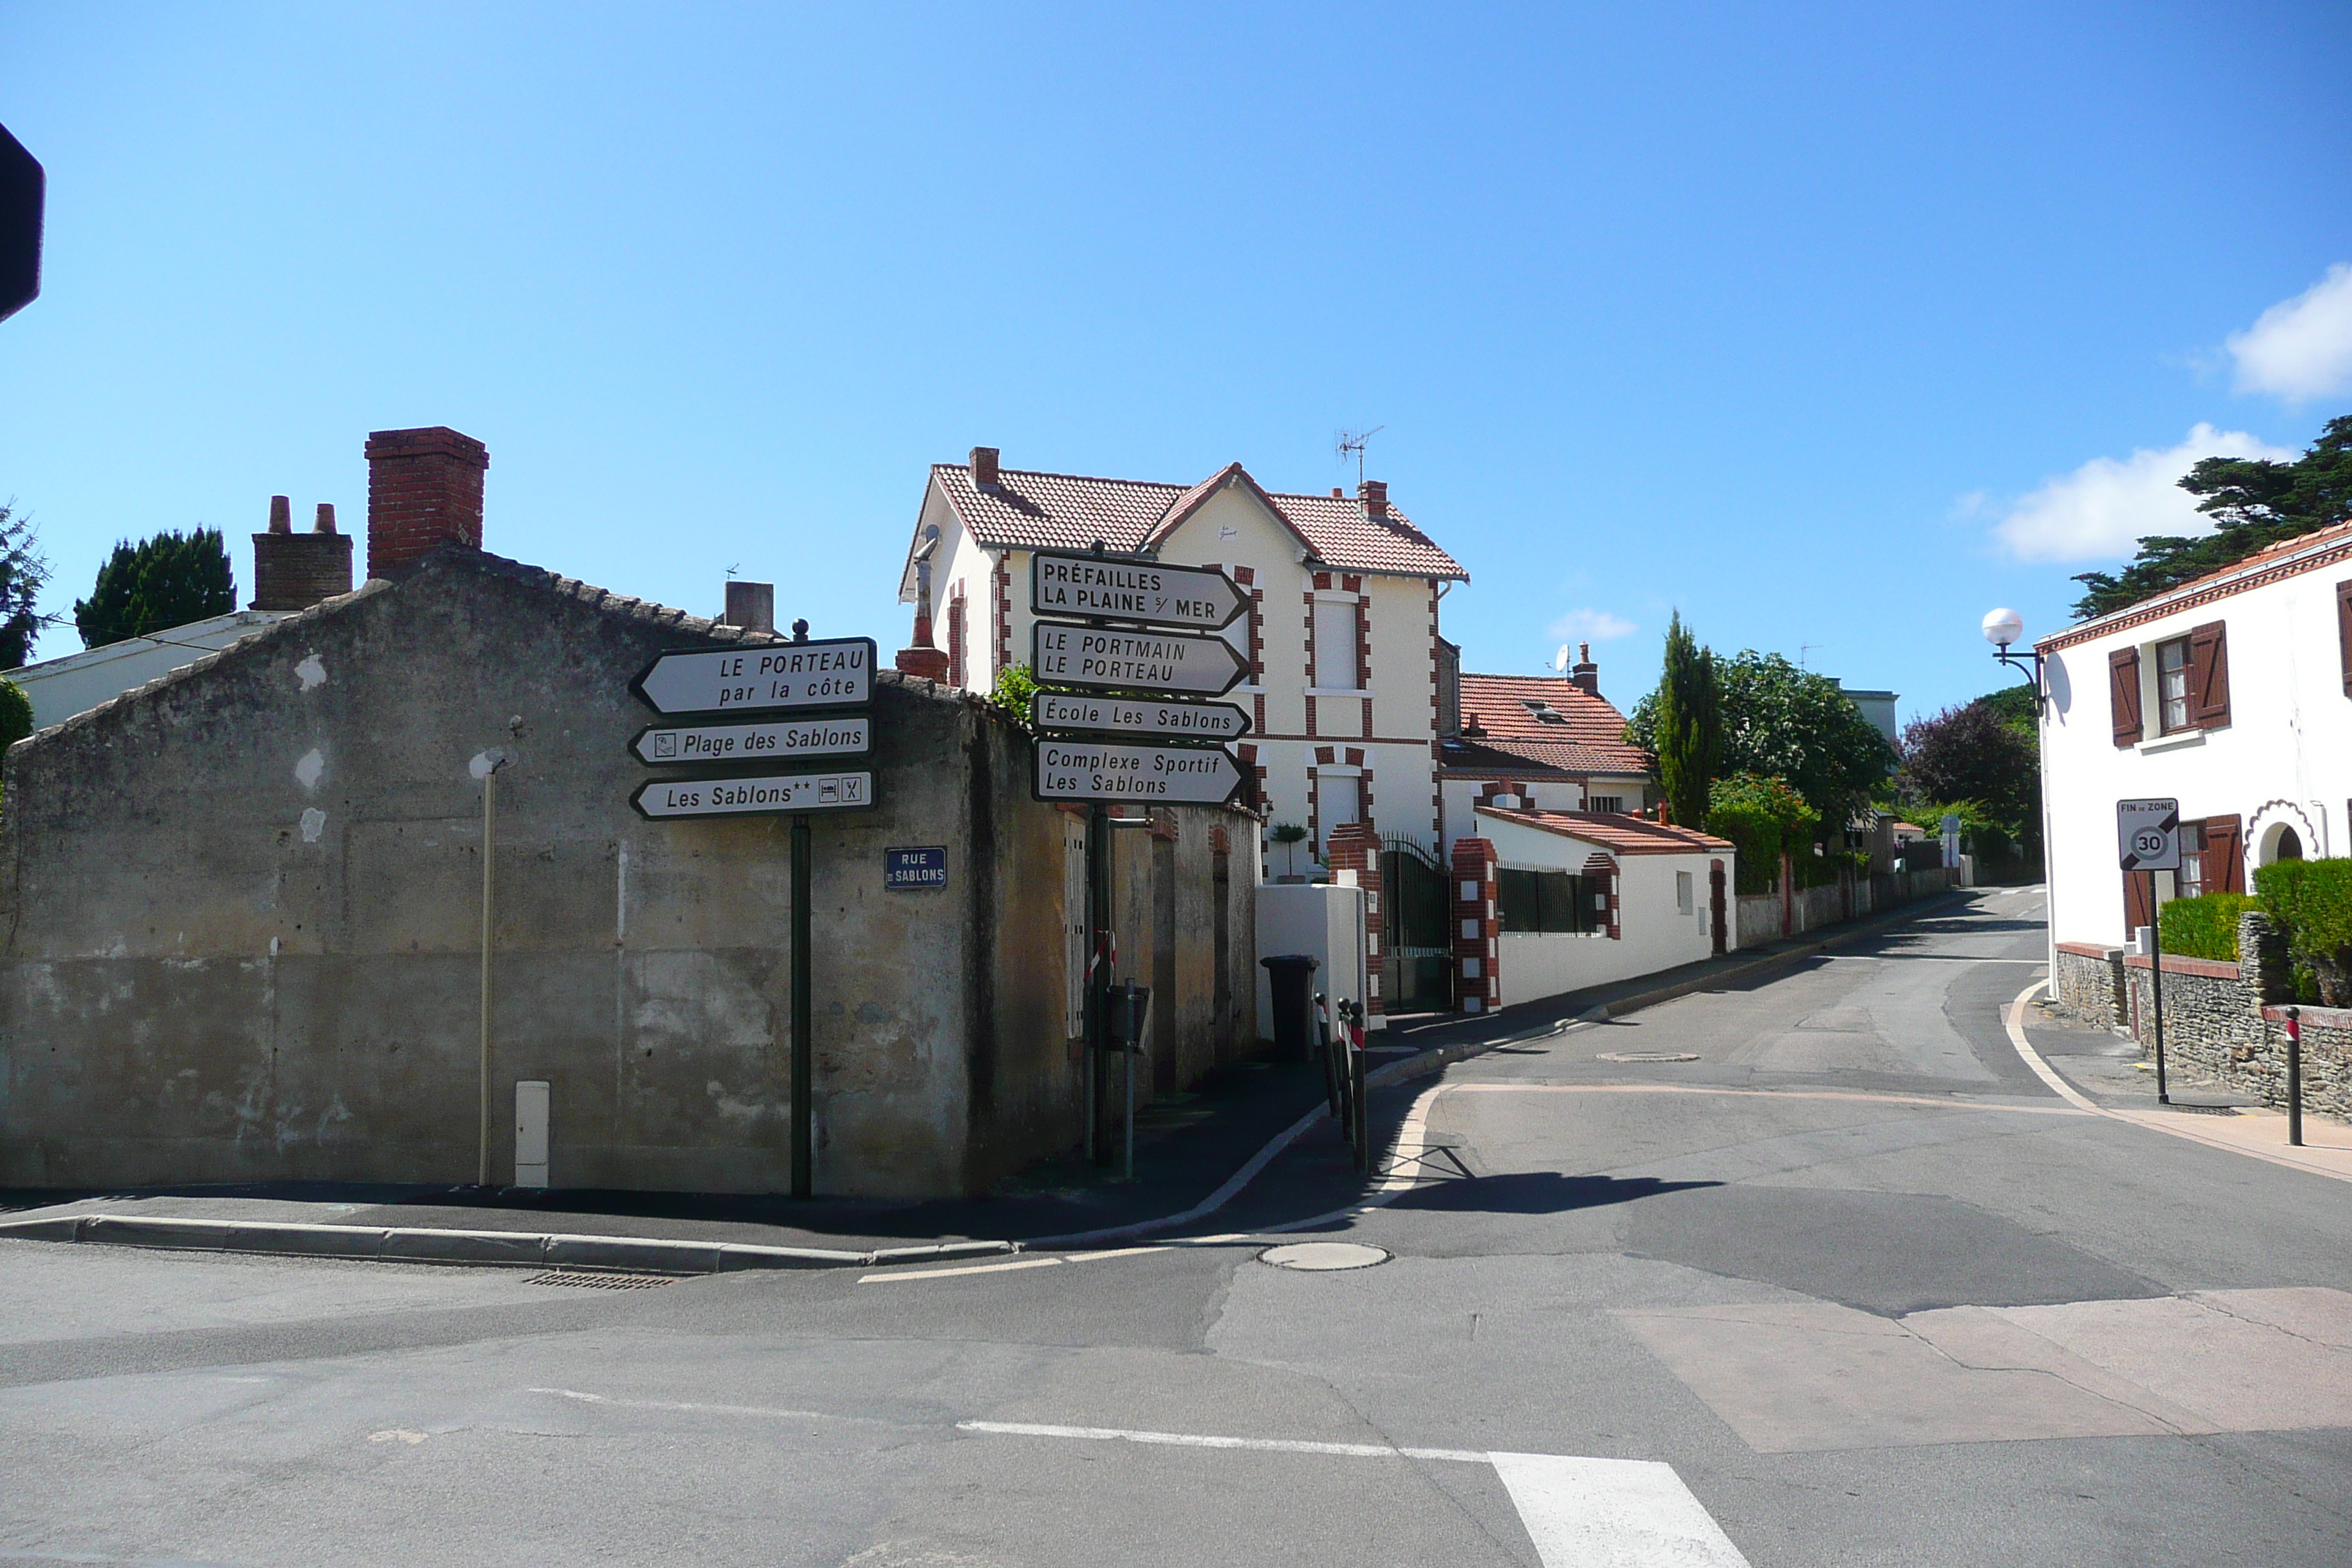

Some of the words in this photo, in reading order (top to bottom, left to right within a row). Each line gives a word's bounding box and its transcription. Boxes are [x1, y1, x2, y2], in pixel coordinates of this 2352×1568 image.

[1044, 562, 1161, 591] PRÉFAILLES
[1044, 587, 1067, 605] LA
[1077, 589, 1146, 612] PLAINE
[1176, 600, 1215, 619] MER
[1045, 633, 1067, 650] LE
[1082, 636, 1185, 660] PORTMAIN
[720, 659, 744, 677] LE
[760, 650, 864, 676] PORTEAU
[1045, 655, 1067, 673] LE
[1082, 658, 1173, 681] PORTEAU
[718, 685, 755, 706] par
[771, 681, 791, 698] la
[807, 677, 856, 696] côte
[1046, 698, 1099, 722] École
[1113, 706, 1143, 724] Les
[1157, 709, 1231, 729] Sablons
[683, 734, 734, 756] Plage
[745, 731, 776, 750] des
[785, 727, 862, 748] Sablons
[1046, 749, 1140, 772] Complexe
[1153, 754, 1220, 775] Sportif
[1046, 772, 1077, 790] Les
[1091, 774, 1166, 794] Sablons
[667, 789, 700, 807] Les
[2121, 803, 2136, 812] FIN
[2148, 802, 2174, 811] ZONE
[2138, 836, 2160, 851] 30
[902, 853, 927, 864] RUE
[895, 869, 944, 882] SABLONS
